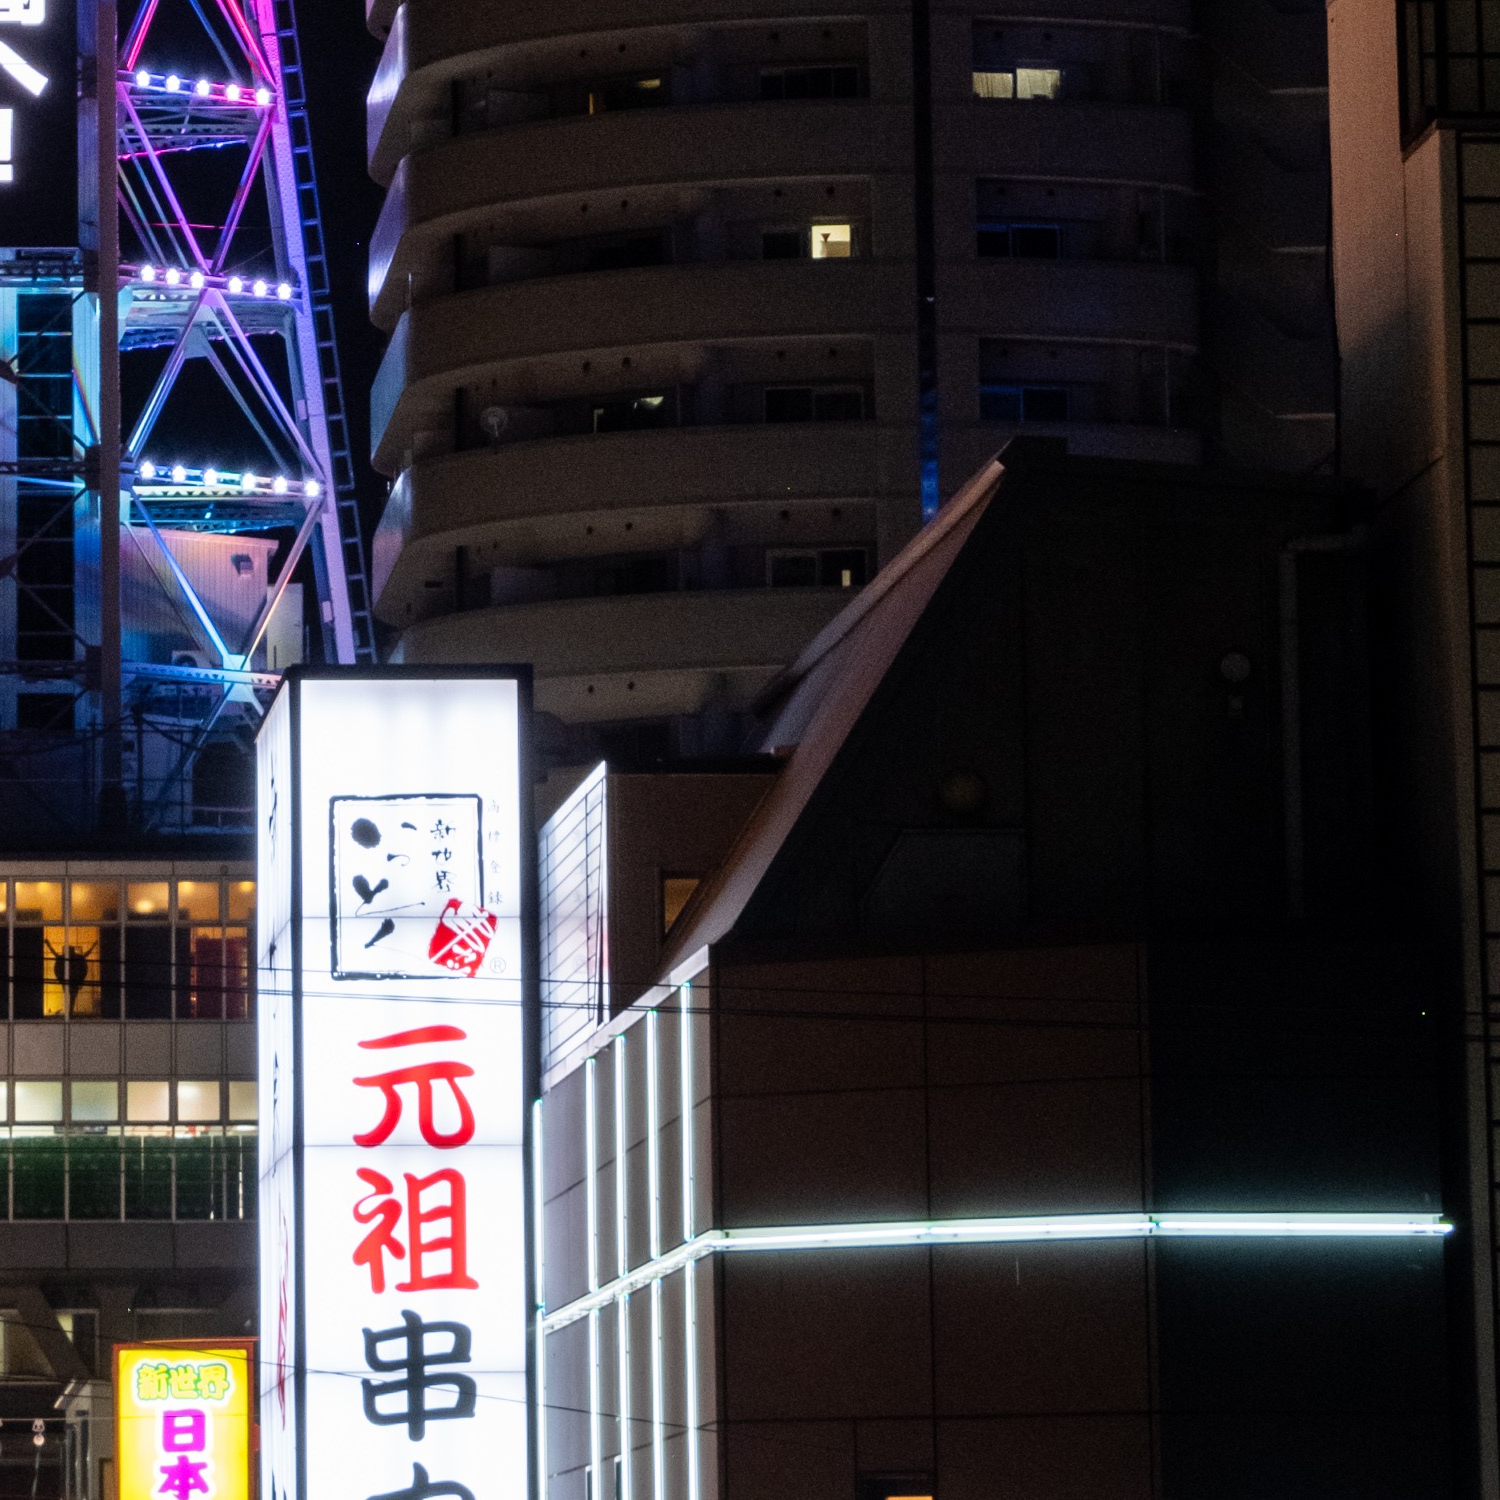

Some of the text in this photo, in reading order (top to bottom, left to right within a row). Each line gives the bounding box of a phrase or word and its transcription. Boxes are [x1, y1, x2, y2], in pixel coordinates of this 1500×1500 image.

[136, 1362, 230, 1401] 新世界
[158, 1408, 209, 1500] 日本
